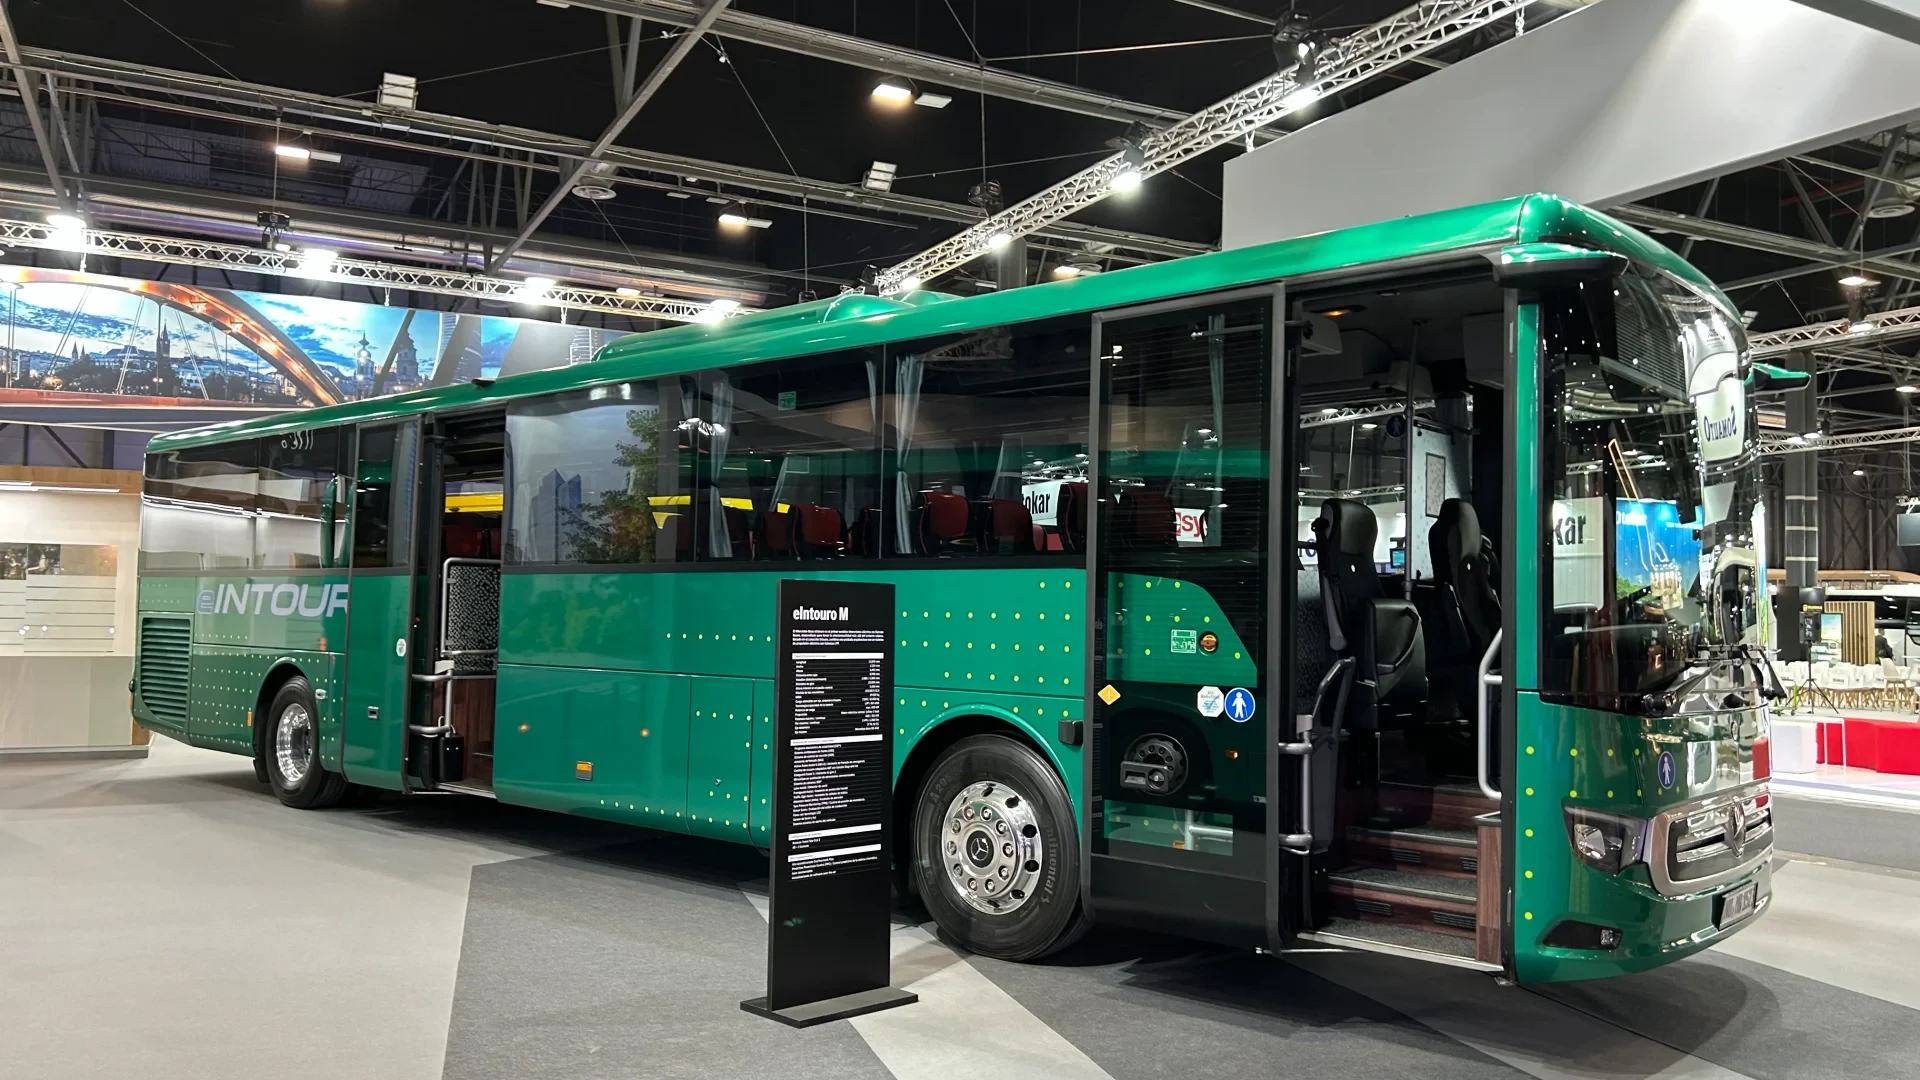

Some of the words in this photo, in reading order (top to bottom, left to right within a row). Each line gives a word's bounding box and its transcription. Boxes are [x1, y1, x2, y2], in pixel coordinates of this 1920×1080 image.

[1022, 491, 1050, 515] okar
[792, 606, 837, 620] eIntouro
[839, 607, 849, 621] M
